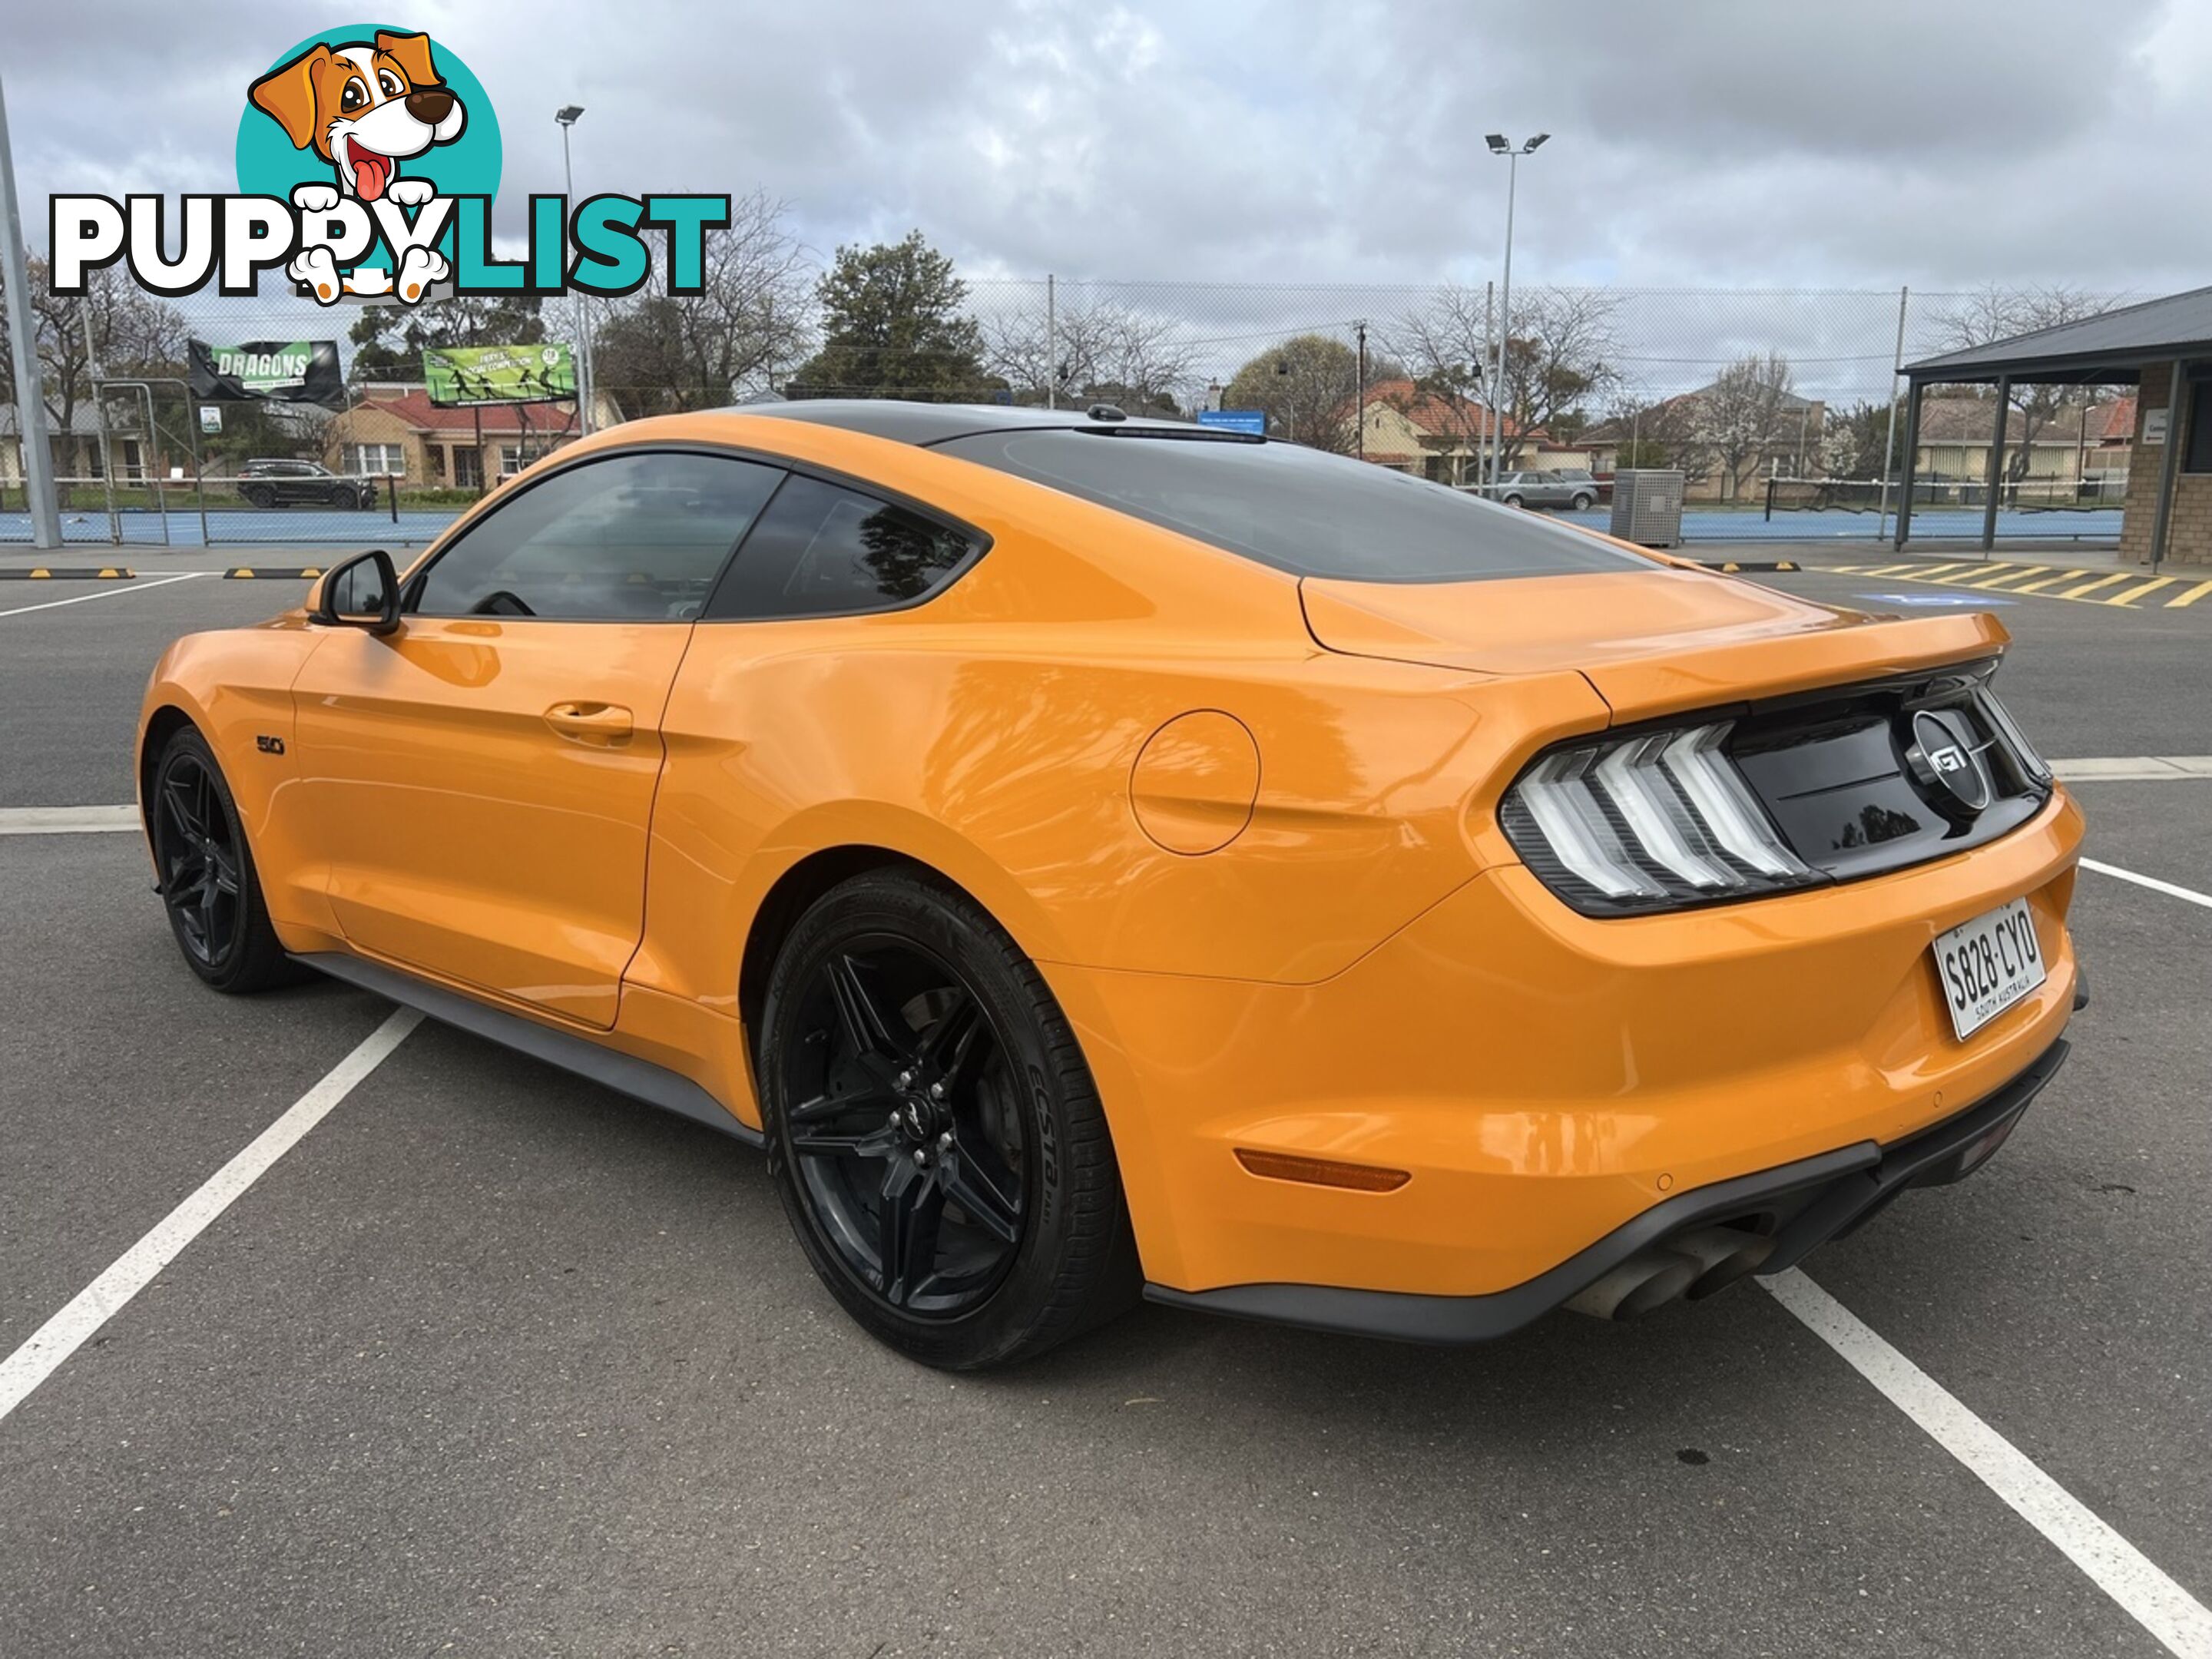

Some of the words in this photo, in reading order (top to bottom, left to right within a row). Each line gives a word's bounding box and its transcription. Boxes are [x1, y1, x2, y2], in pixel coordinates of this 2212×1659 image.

[217, 353, 307, 376] DRAGONS
[1931, 745, 1967, 771] GT
[1975, 998, 1997, 1020] SOUTH
[1998, 975, 2030, 1003] AUSTRALIA
